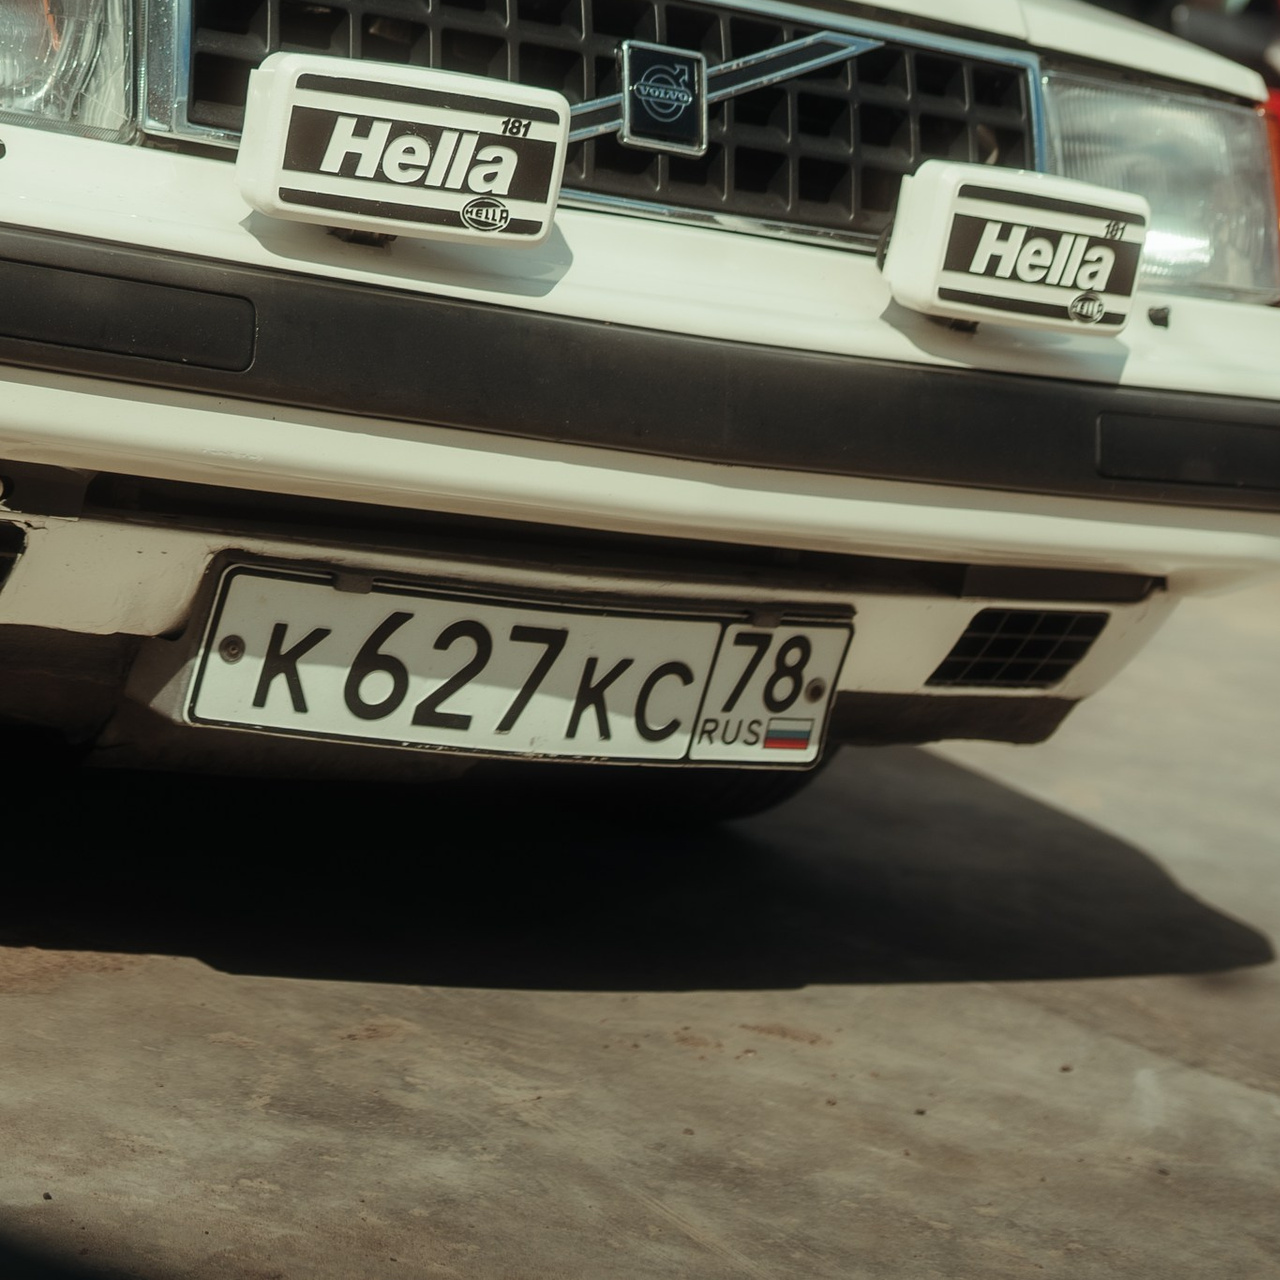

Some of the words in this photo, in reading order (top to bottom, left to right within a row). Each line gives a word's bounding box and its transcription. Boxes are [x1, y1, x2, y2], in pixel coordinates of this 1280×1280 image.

[638, 85, 689, 101] VOLVO
[501, 117, 532, 138] 181
[319, 115, 519, 195] Hella
[465, 208, 509, 225] HELLA
[968, 221, 1116, 292] Hella
[721, 631, 812, 713] 78
[696, 718, 764, 746] RUS
